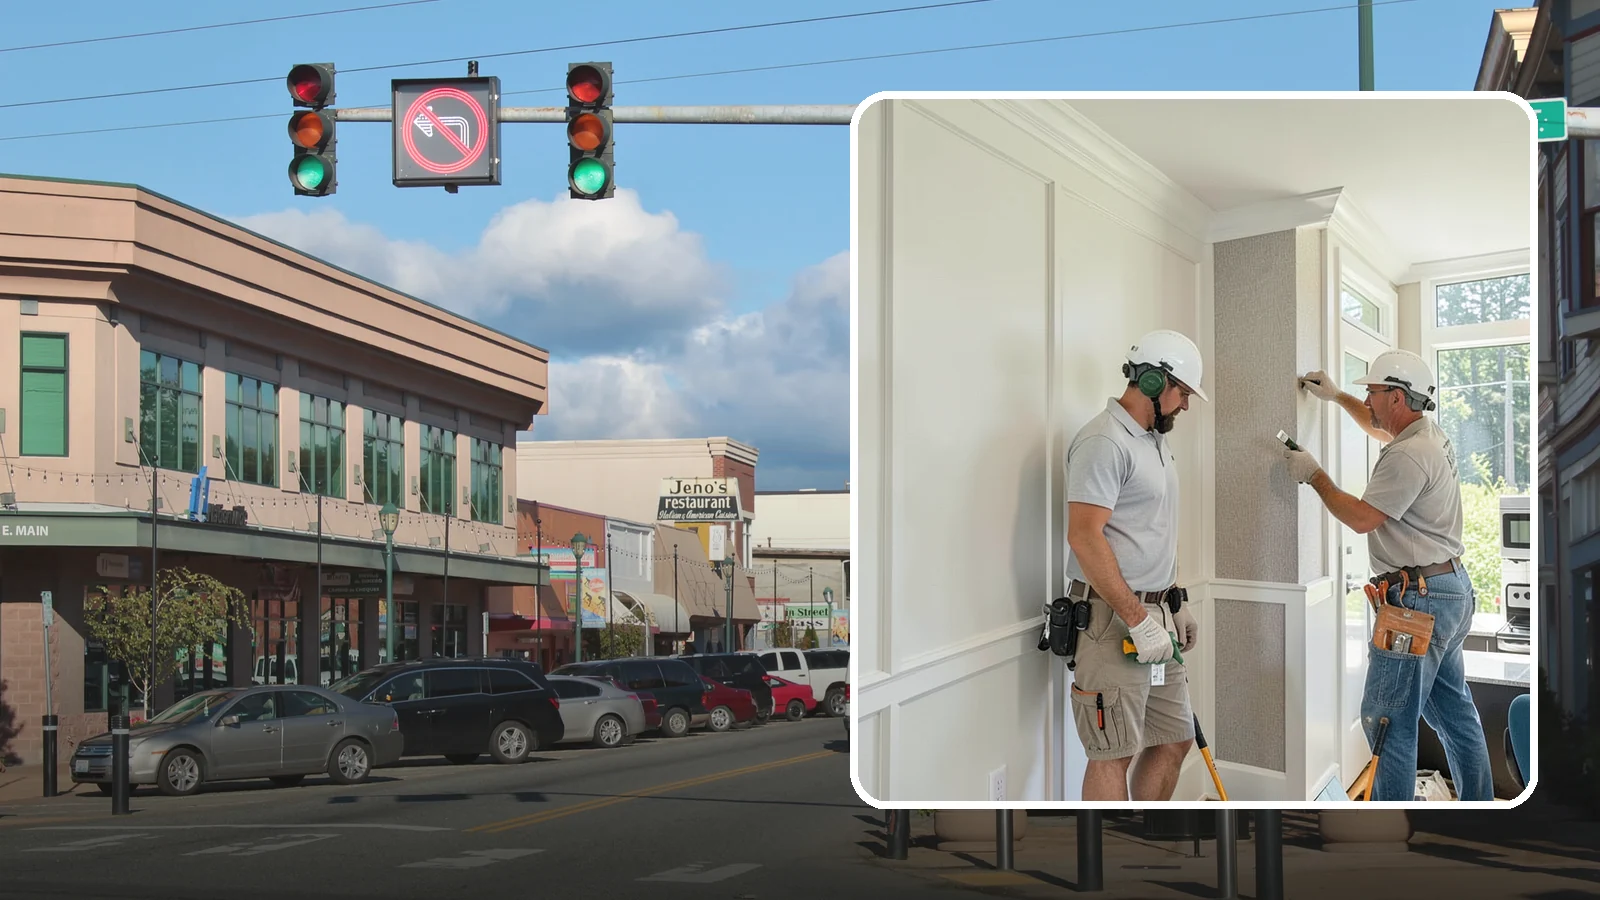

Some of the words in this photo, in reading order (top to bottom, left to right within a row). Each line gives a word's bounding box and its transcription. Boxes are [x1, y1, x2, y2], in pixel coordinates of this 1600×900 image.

[670, 480, 727, 494] Jeno's
[665, 496, 731, 509] restaurant
[658, 510, 681, 519] Italian
[686, 510, 715, 519] American
[715, 509, 738, 519] Cuisine
[2, 525, 13, 536] E.
[15, 525, 49, 536] MAIN
[797, 607, 829, 617] Street
